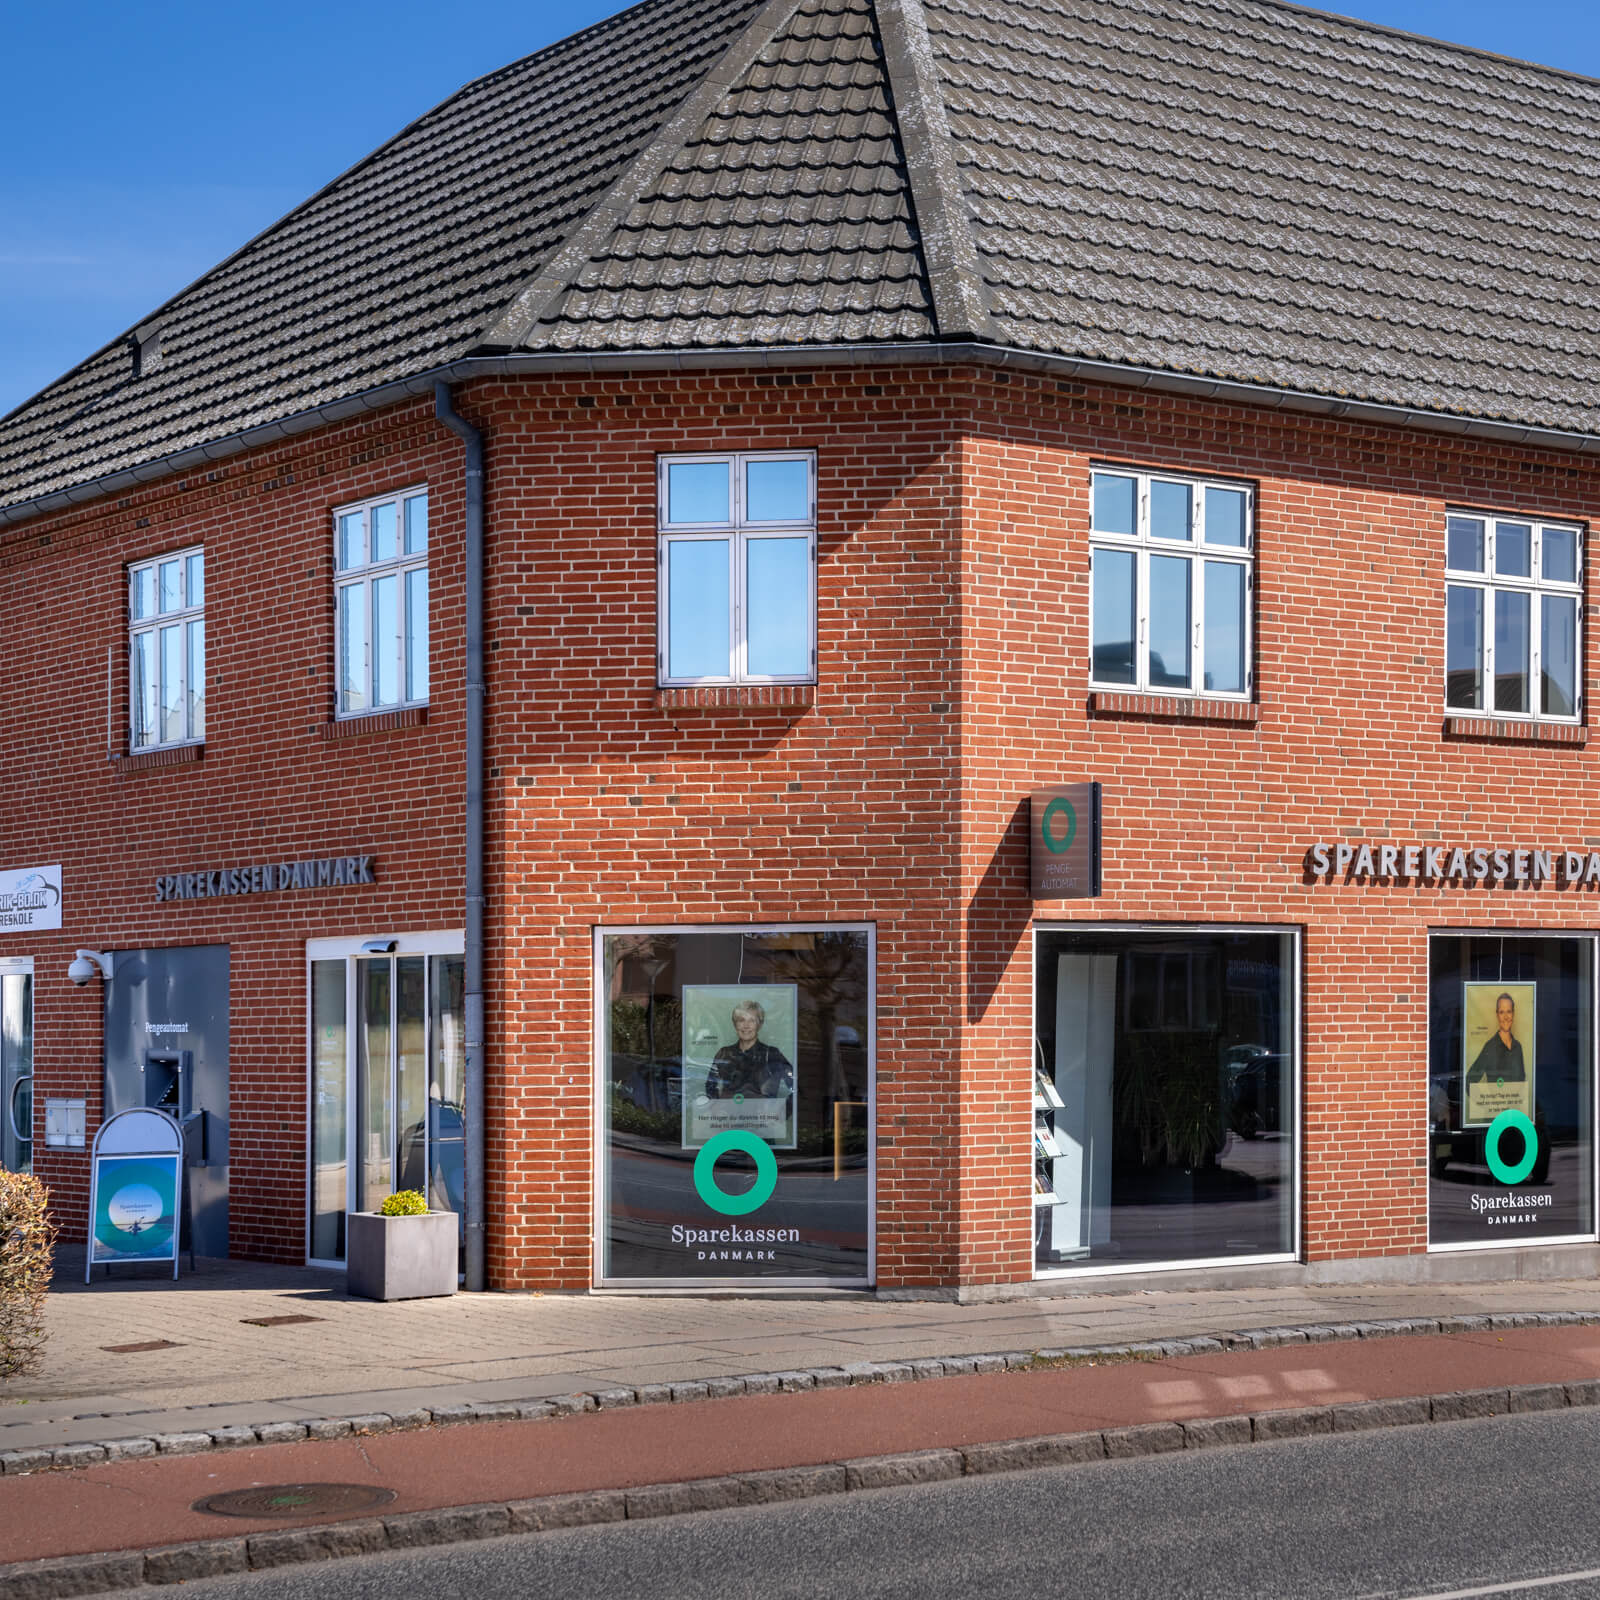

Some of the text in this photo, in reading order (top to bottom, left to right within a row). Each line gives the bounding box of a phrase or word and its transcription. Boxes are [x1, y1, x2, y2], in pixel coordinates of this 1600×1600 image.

[1312, 842, 1552, 881] SPAREKASSEN
[156, 856, 374, 901] SPAREKASSEN DANMARK
[1041, 877, 1080, 890] AUTOMAT
[145, 1021, 189, 1036] Pengeautomat
[1471, 1192, 1552, 1214] Sparekassen
[1488, 1214, 1537, 1225] DANMARK
[671, 1224, 800, 1247] Sparekassen
[697, 1250, 776, 1260] DANMARK
